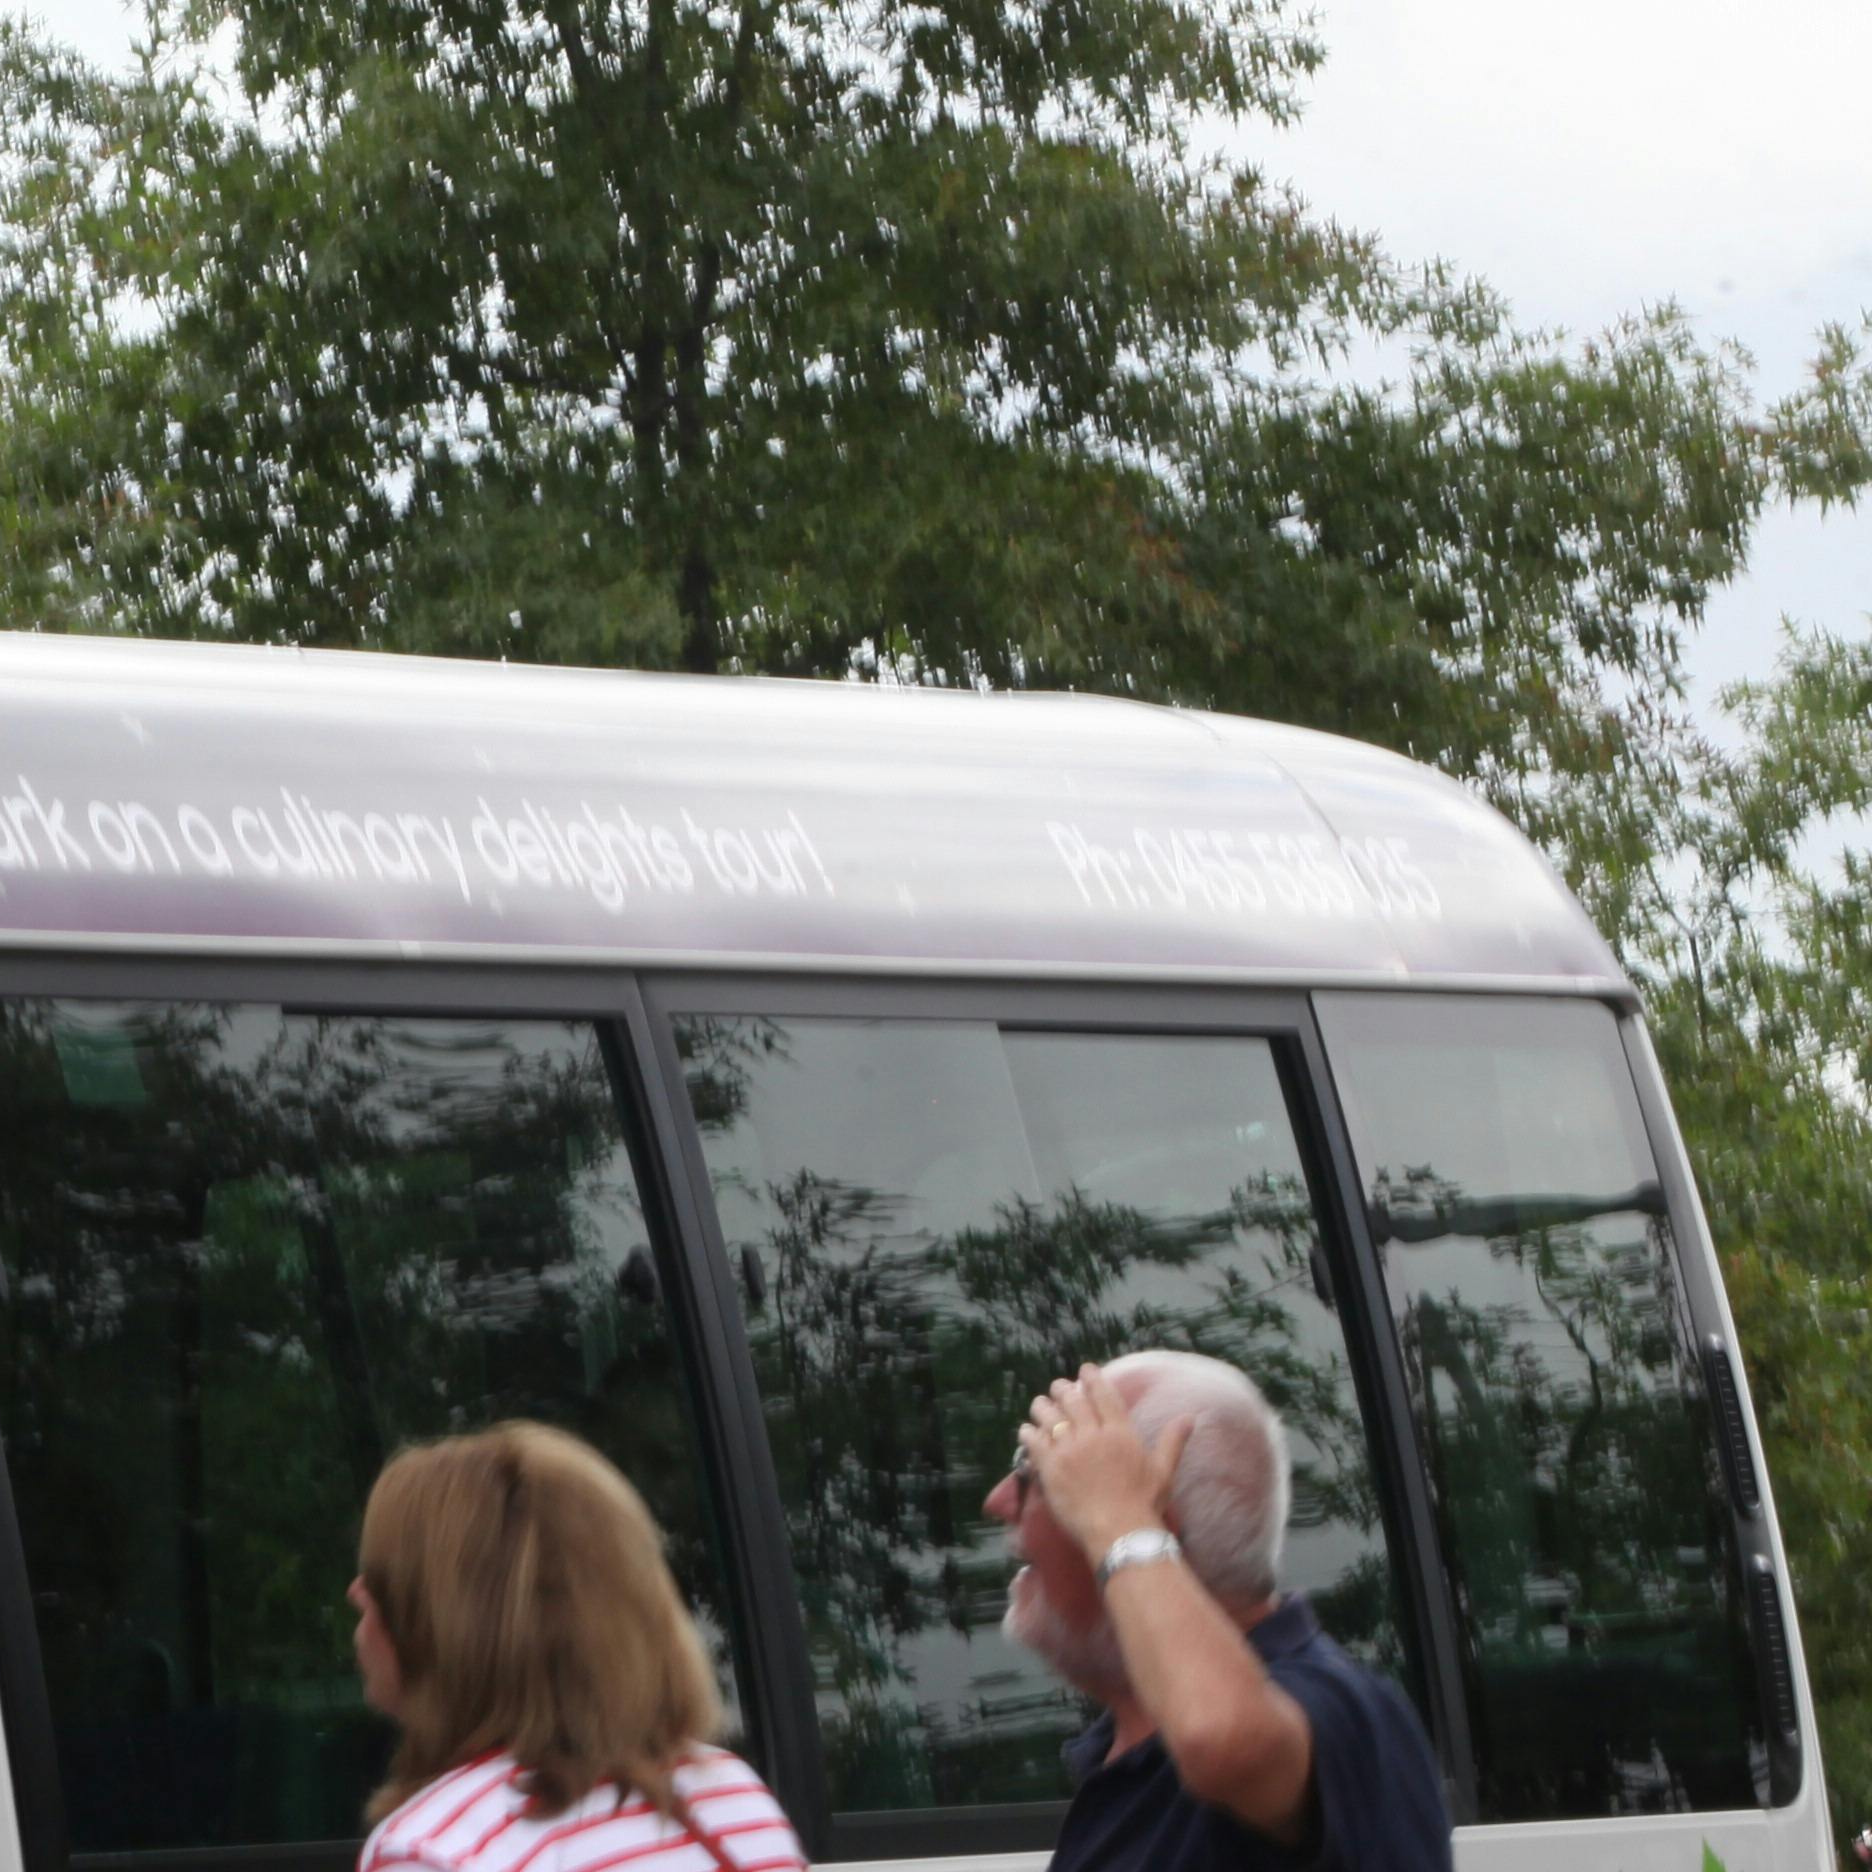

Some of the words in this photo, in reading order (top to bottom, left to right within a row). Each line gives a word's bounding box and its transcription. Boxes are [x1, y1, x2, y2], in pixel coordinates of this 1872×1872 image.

[87, 802, 179, 875] on
[177, 803, 234, 878] a
[231, 786, 471, 905] culinary
[471, 794, 695, 915] delights
[680, 805, 837, 898] tour!
